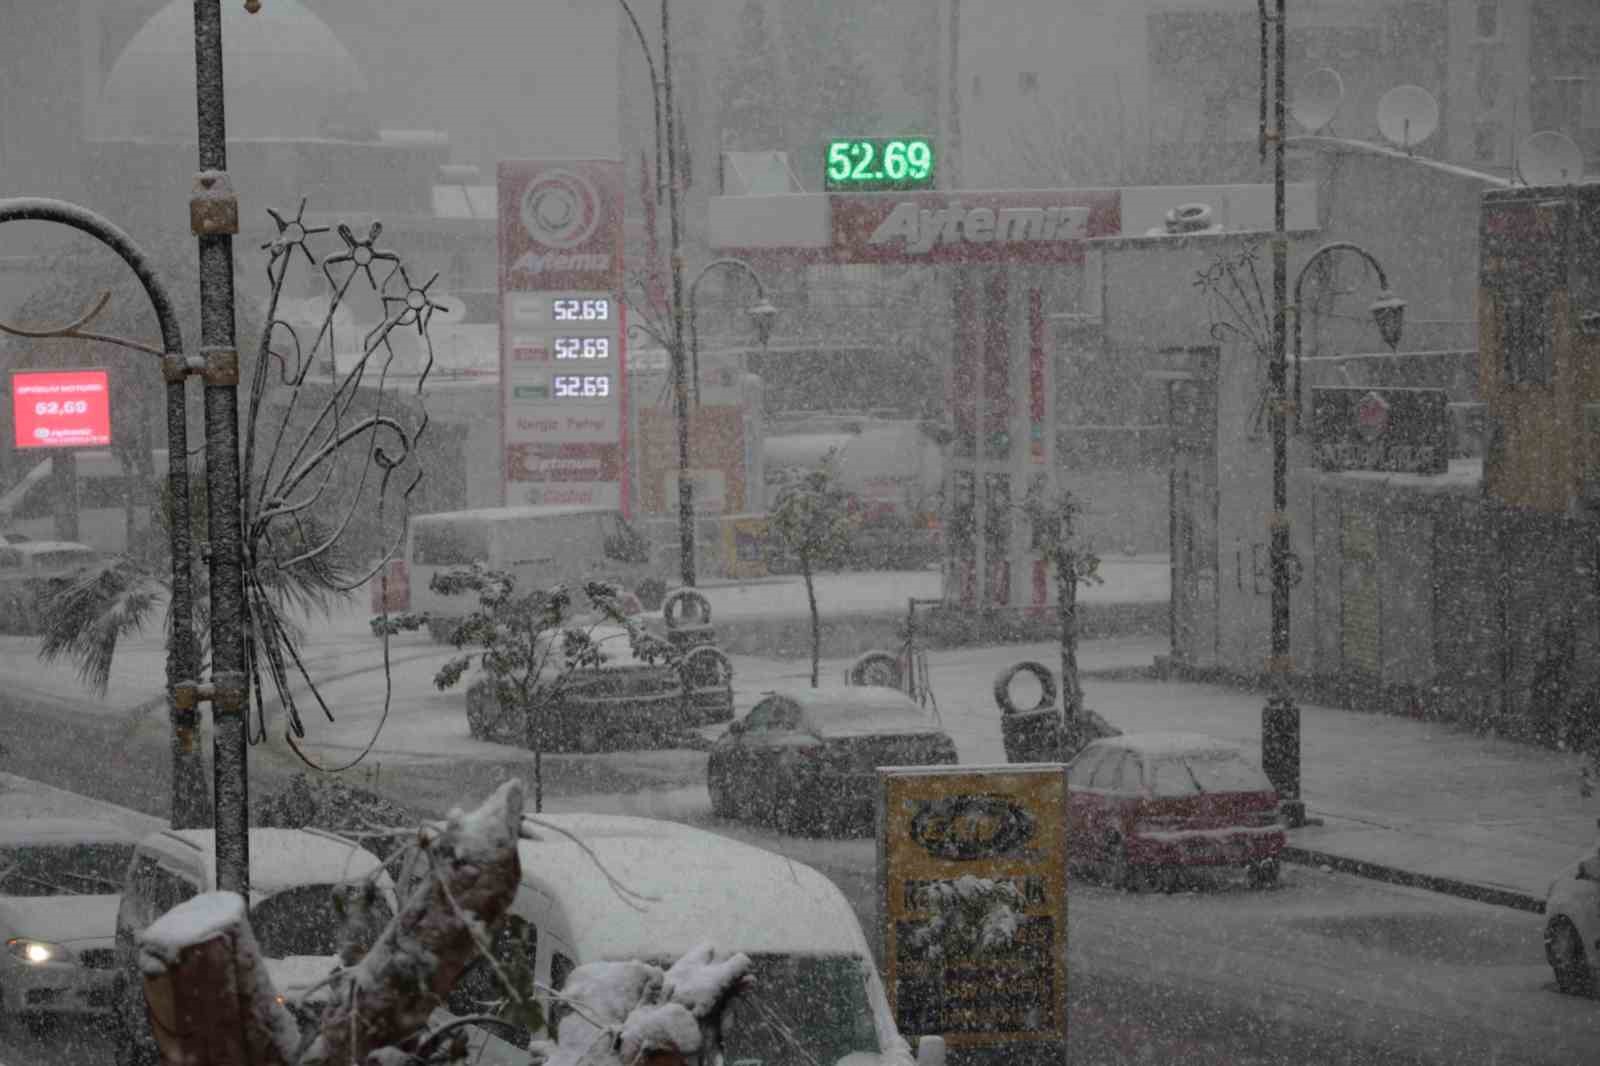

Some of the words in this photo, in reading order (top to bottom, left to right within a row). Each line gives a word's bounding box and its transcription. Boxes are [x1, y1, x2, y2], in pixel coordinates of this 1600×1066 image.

[828, 142, 931, 180] 52.69
[866, 202, 1090, 255] Aytemiz
[512, 251, 608, 273] Aytemiz
[553, 300, 609, 320] 52.69
[555, 338, 609, 359] 52.69
[555, 376, 609, 396] 52.69
